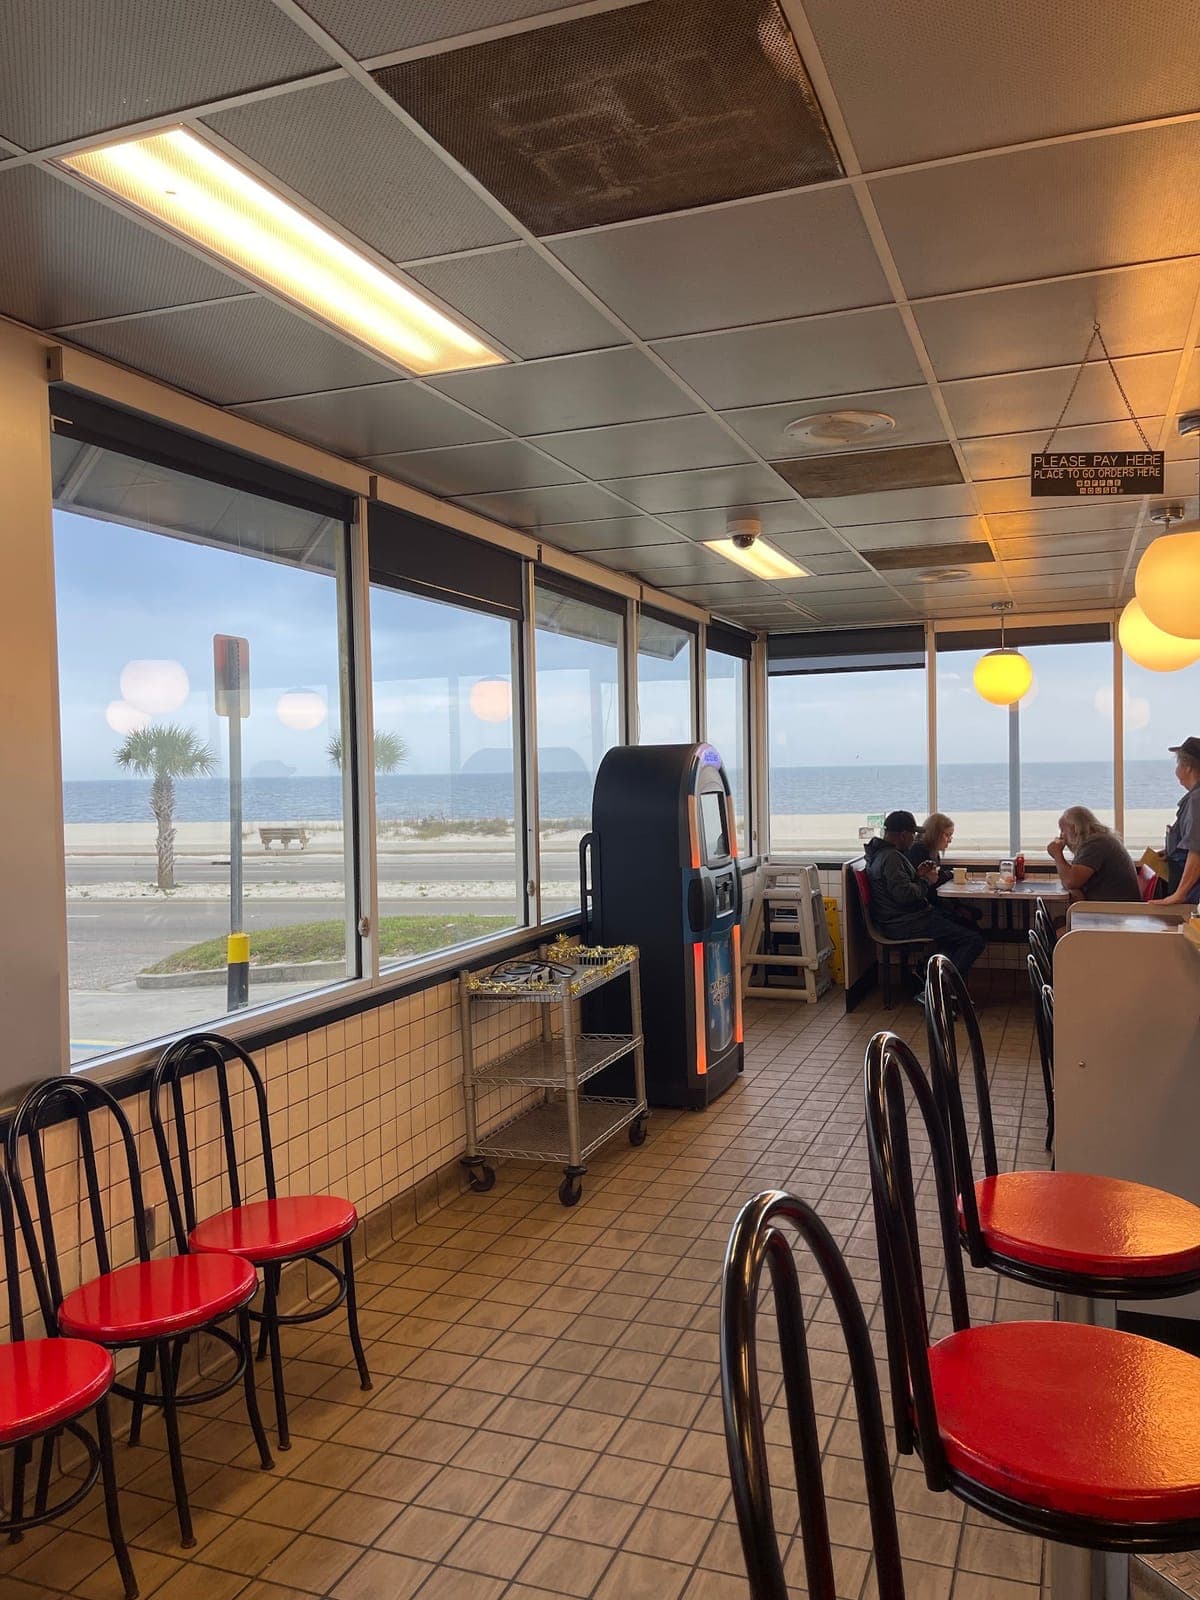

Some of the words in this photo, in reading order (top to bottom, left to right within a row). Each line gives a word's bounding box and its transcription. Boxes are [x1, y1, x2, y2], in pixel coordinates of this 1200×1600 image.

[1033, 455, 1087, 468] PLEASE
[1093, 455, 1118, 466] PAY
[1126, 454, 1161, 465] HERE
[1033, 469, 1064, 479] PLACE
[1068, 469, 1080, 479] TO
[1082, 469, 1095, 478] GO
[1098, 468, 1134, 478] ORDERS
[1137, 467, 1161, 477] HERE
